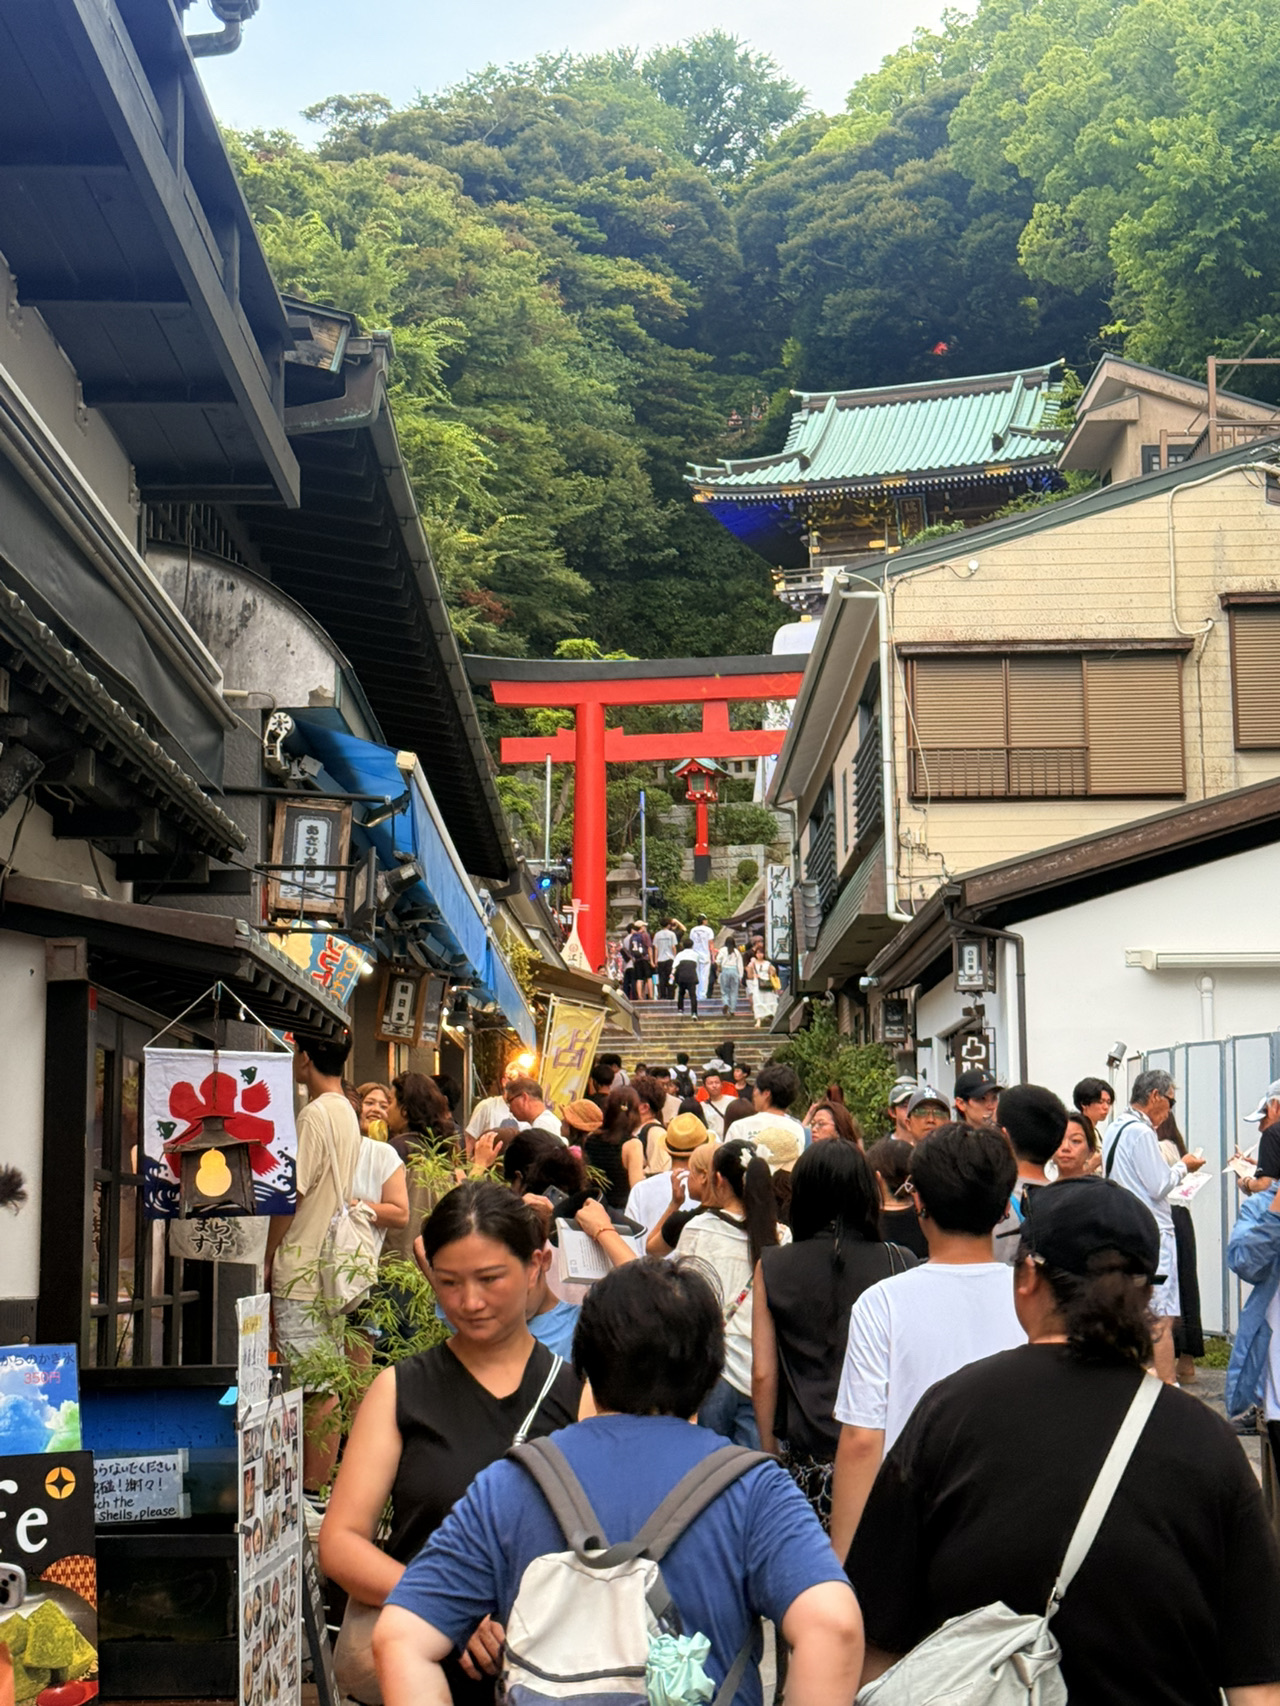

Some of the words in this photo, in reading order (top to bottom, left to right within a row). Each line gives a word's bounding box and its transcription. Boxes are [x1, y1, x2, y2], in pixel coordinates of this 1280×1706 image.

[24, 1371, 61, 1385] 350円
[94, 1496, 110, 1510] ch
[113, 1496, 134, 1509] the
[140, 1507, 177, 1521] please
